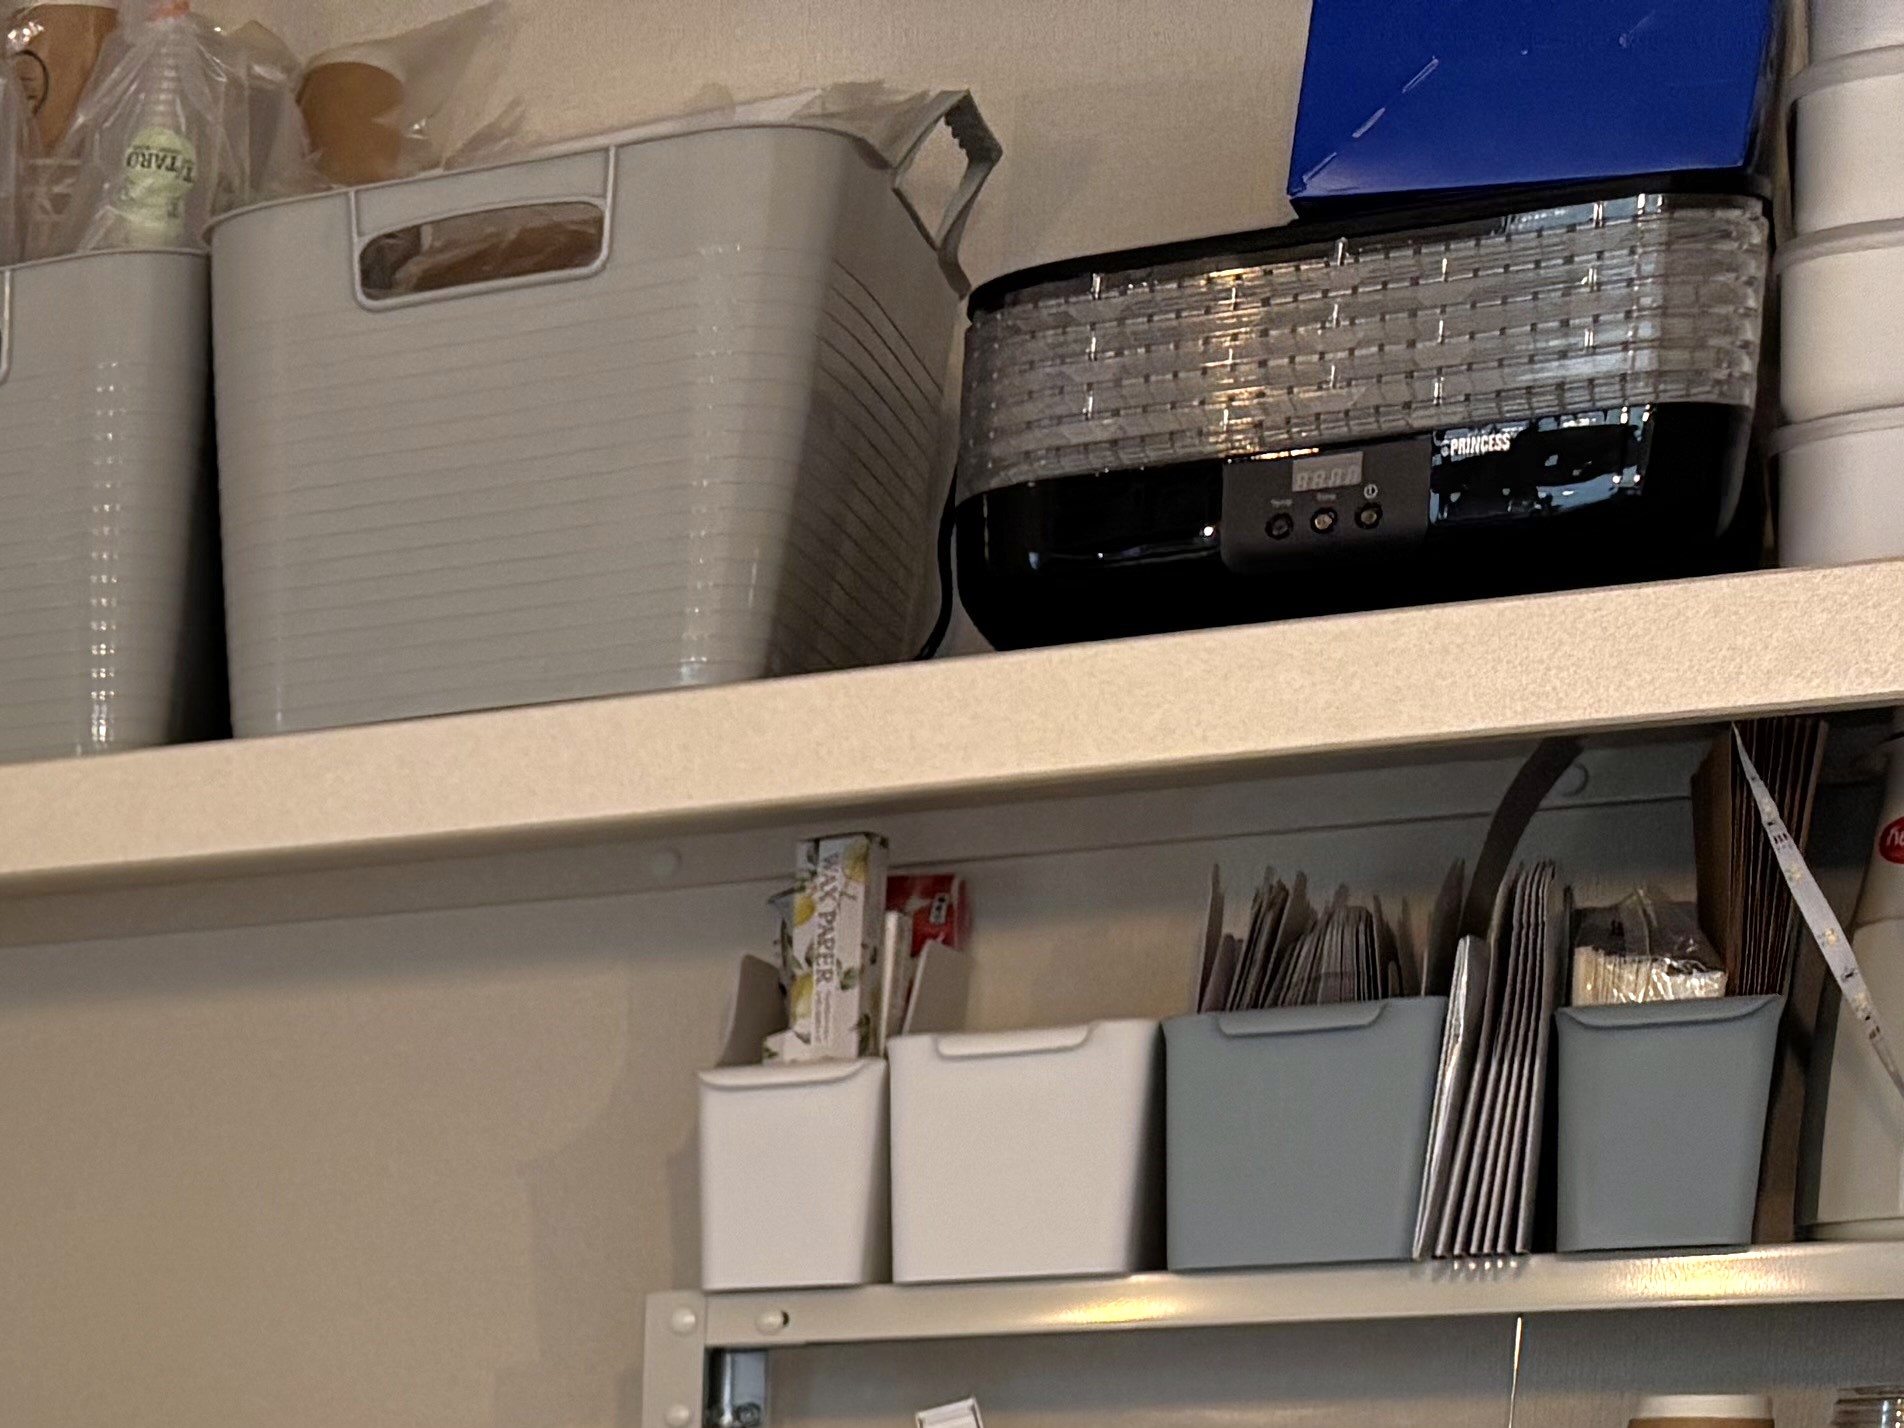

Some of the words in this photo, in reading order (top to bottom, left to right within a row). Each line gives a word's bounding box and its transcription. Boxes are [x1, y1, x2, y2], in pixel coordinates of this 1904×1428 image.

[1450, 433, 1511, 455] PRINCESS
[818, 853, 840, 908] WAX
[815, 911, 837, 985] PAPER
